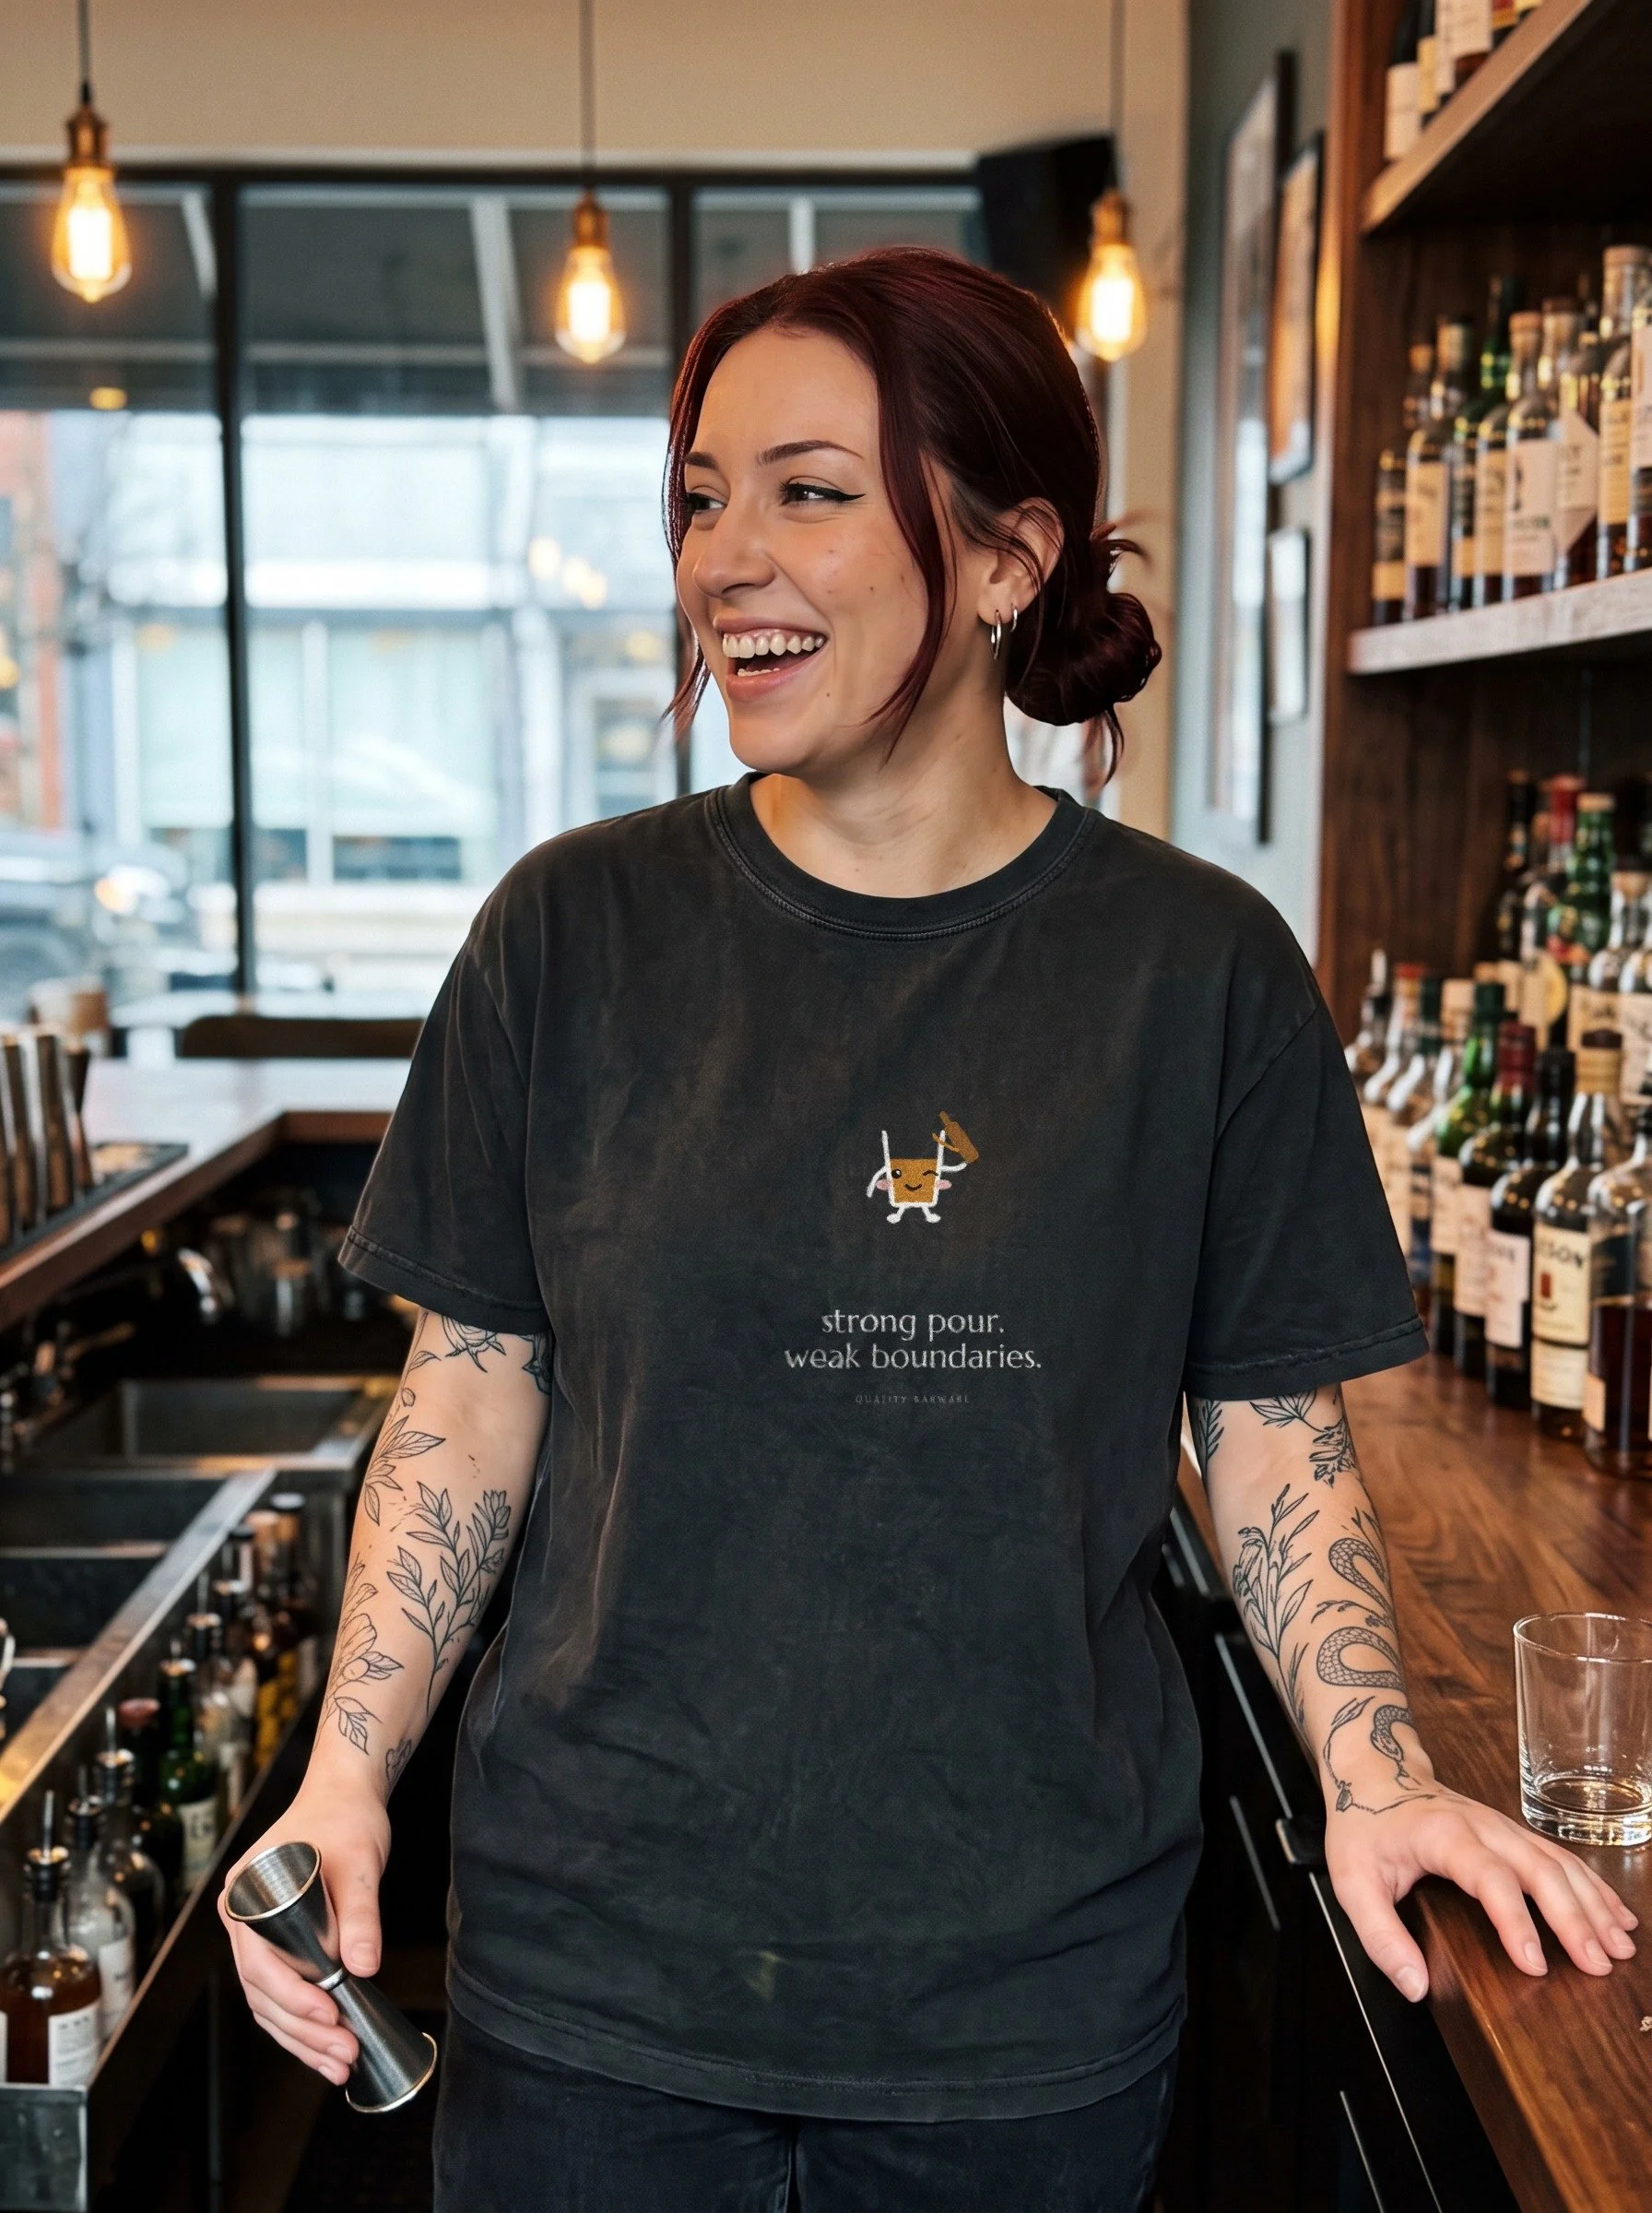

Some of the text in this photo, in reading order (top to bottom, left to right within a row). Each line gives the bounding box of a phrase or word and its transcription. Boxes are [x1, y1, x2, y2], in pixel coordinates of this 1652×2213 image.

[821, 1308, 1004, 1342] strong pour.
[784, 1343, 1042, 1368] weak boundaries.
